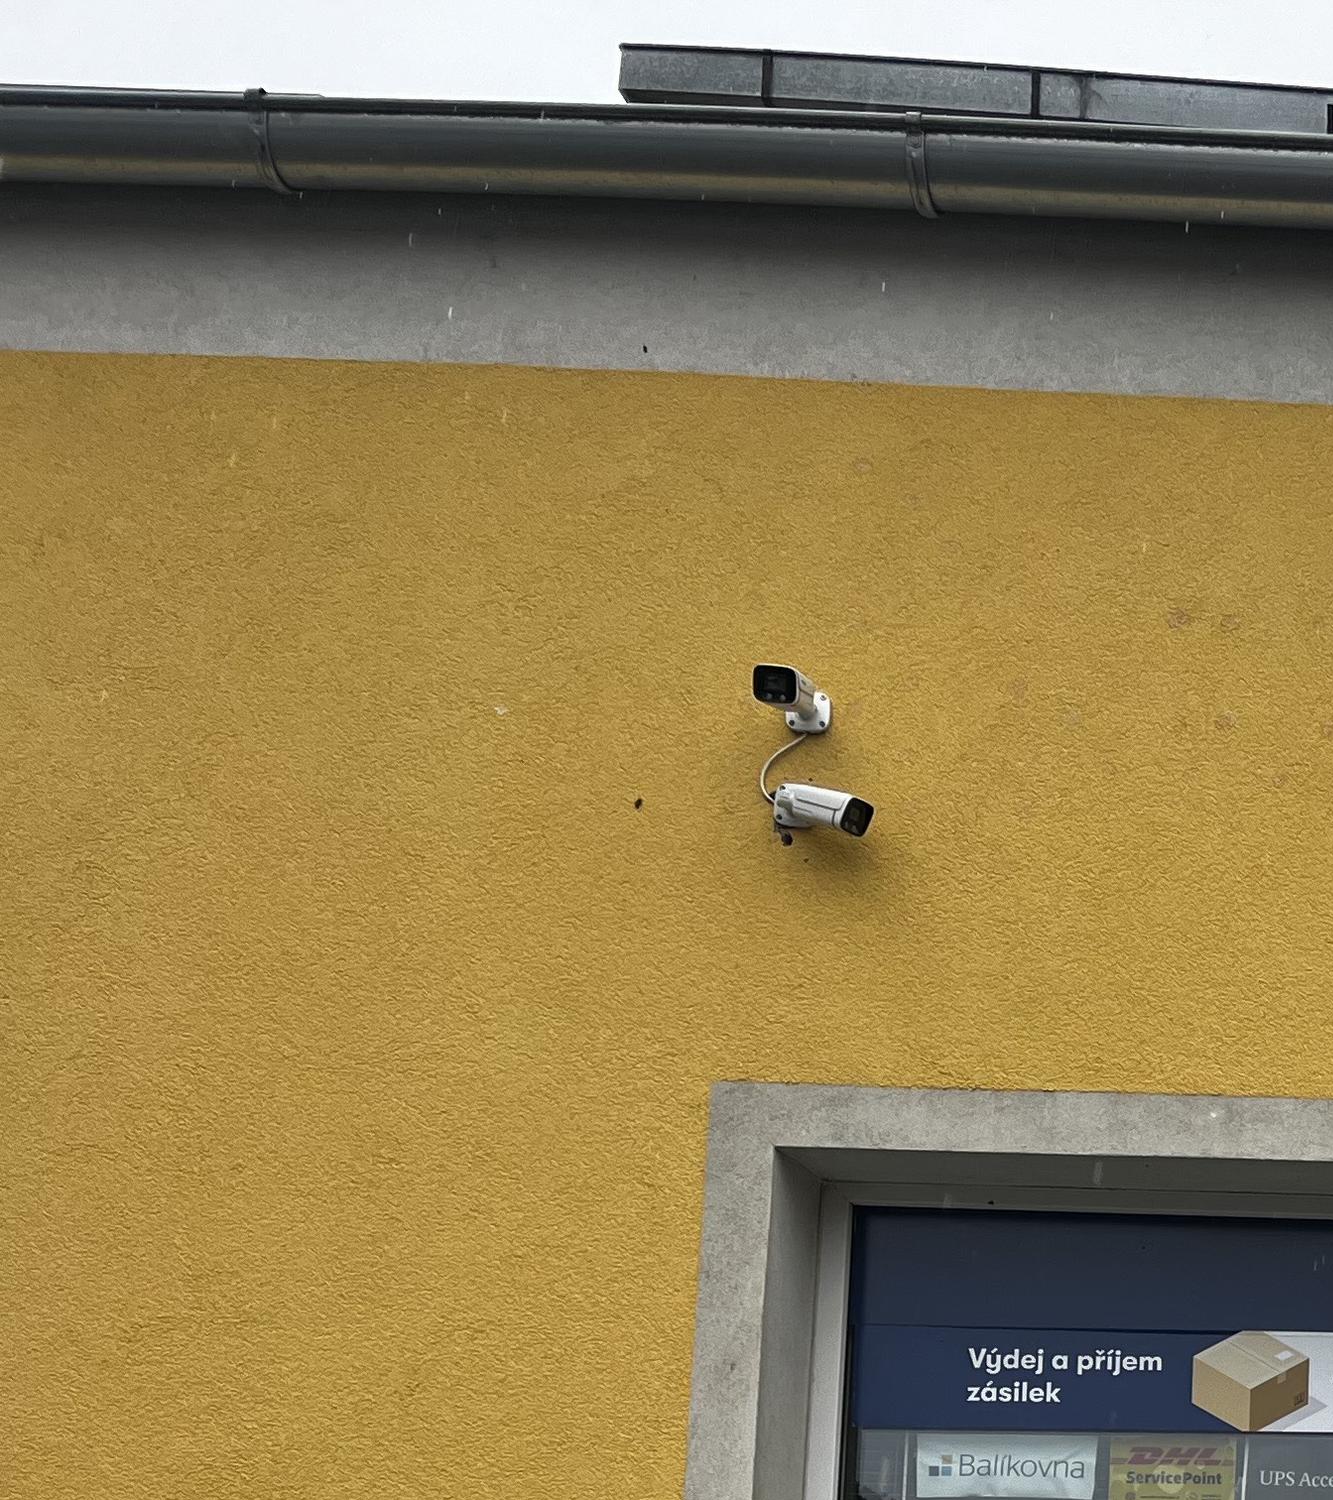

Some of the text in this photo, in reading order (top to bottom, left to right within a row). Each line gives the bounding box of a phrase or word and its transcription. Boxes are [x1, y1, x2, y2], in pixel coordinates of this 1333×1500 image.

[967, 1347, 1163, 1376] Výdej a příjem
[966, 1381, 1061, 1403] zásilek
[958, 1453, 1085, 1479] Balíkovna
[1127, 1446, 1222, 1466] DHL
[1125, 1471, 1223, 1485] ServicePoint
[1259, 1469, 1295, 1487] UPS
